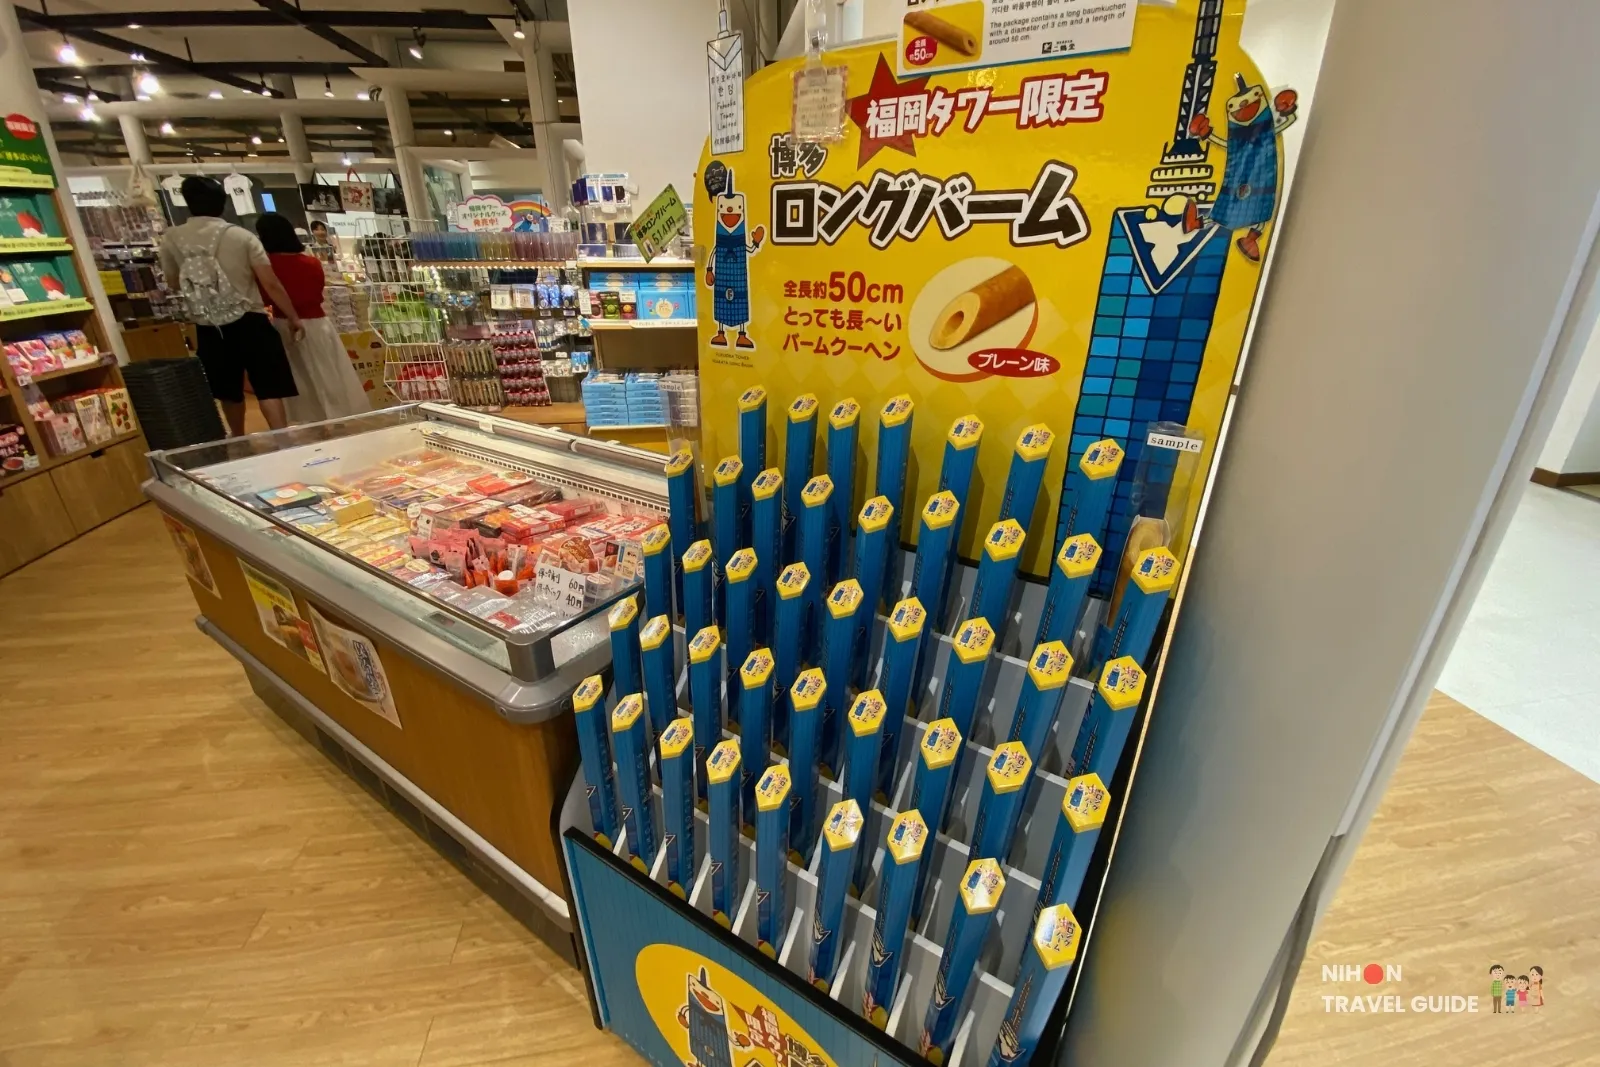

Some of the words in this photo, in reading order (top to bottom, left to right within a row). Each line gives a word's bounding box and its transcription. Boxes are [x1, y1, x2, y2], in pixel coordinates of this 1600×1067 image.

[1003, 18, 1030, 28] package
[1031, 13, 1058, 22] contains
[1082, 3, 1127, 15] baumkuchen
[1011, 25, 1039, 34] diameter
[1092, 13, 1115, 22] length
[989, 36, 1010, 45] around
[865, 71, 1109, 142] 福岡タワー限定
[770, 133, 828, 178] 博多
[771, 162, 1090, 248] ロングバーム
[783, 270, 904, 304] 全長約50cm
[783, 333, 900, 362] バームクーヘン
[976, 352, 1051, 374] プレーン味
[1150, 437, 1198, 450] sample
